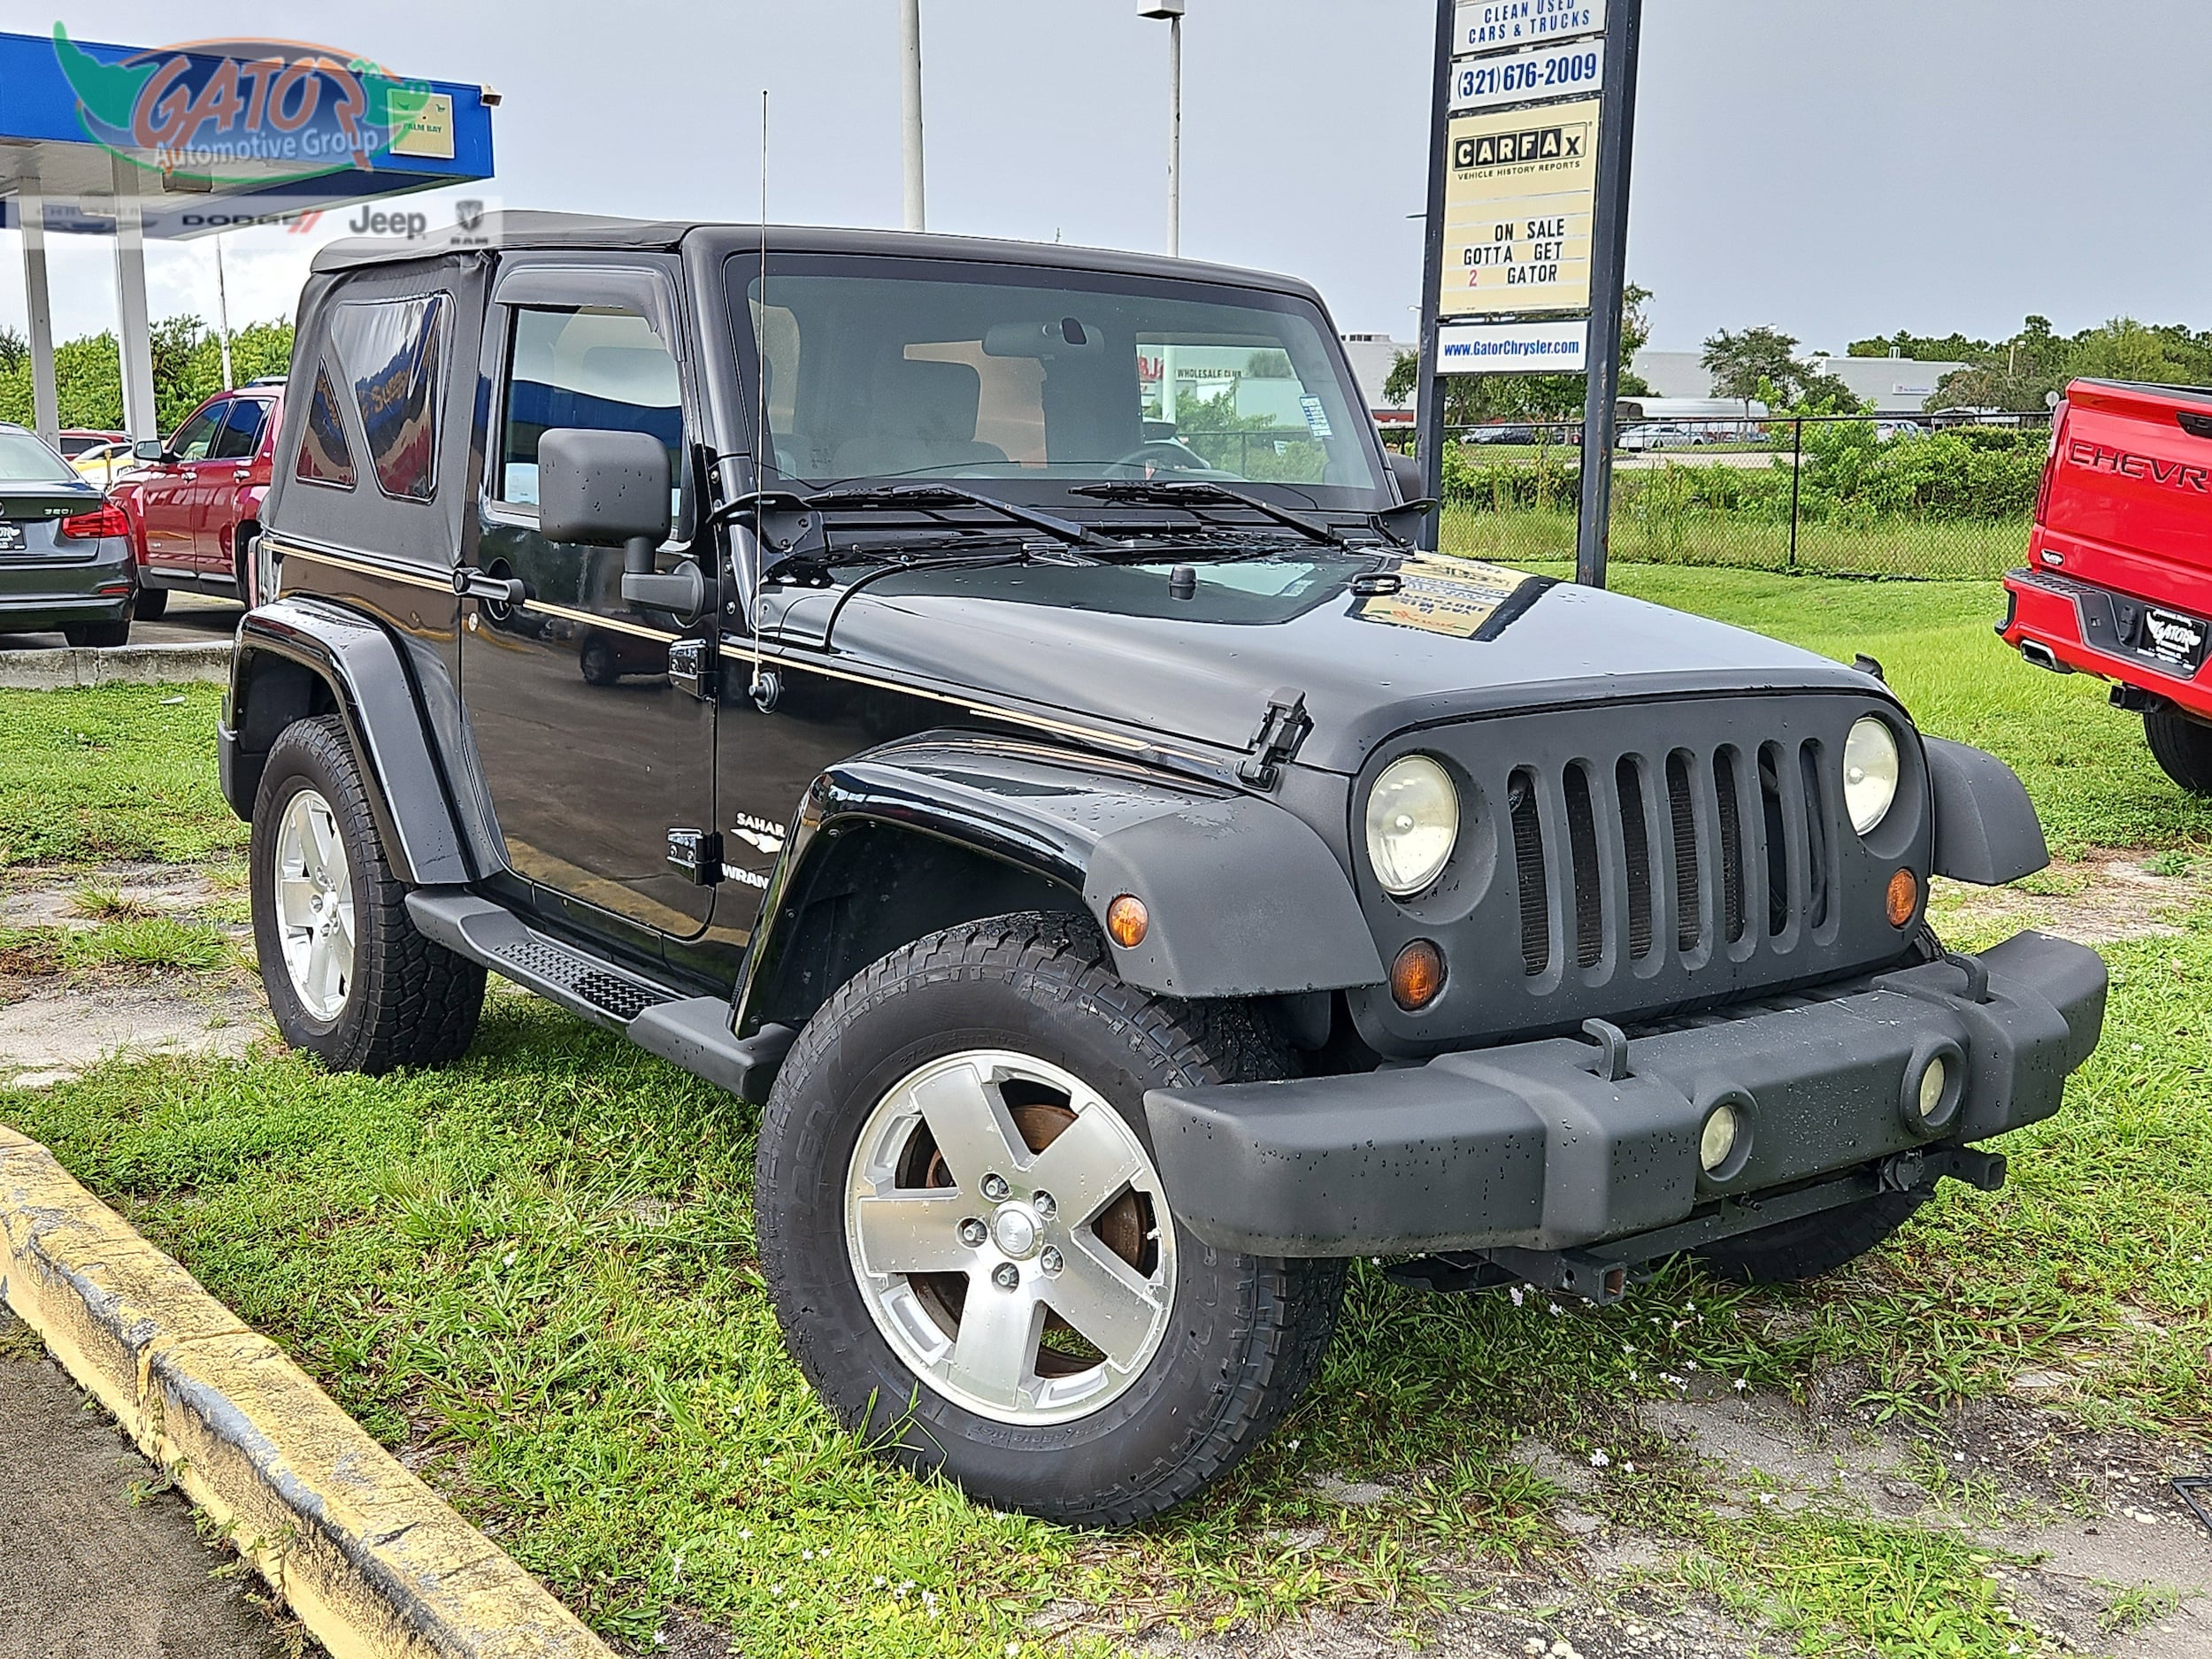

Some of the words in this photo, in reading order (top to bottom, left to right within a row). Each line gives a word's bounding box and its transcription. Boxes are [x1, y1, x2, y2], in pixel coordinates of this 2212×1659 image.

[1485, 2, 1528, 24] CLEAN
[1469, 24, 1505, 43] CARS
[1514, 23, 1522, 37] &
[1531, 10, 1590, 35] TRUCKS
[1456, 130, 1582, 166] CARFAX
[1458, 170, 1494, 180] VEHICLE
[1497, 165, 1535, 176] HISTORY
[1539, 160, 1581, 171] REPORTS
[1494, 223, 1514, 242] ON
[1527, 219, 1564, 240] SALE
[1464, 244, 1513, 266] GOTTA
[1534, 242, 1563, 261] GET
[1469, 269, 1478, 287] 2
[1507, 265, 1557, 285] GATOR
[1444, 339, 1579, 357] www.GatorChrysler.com
[1177, 368, 1222, 379] WHOLESALE
